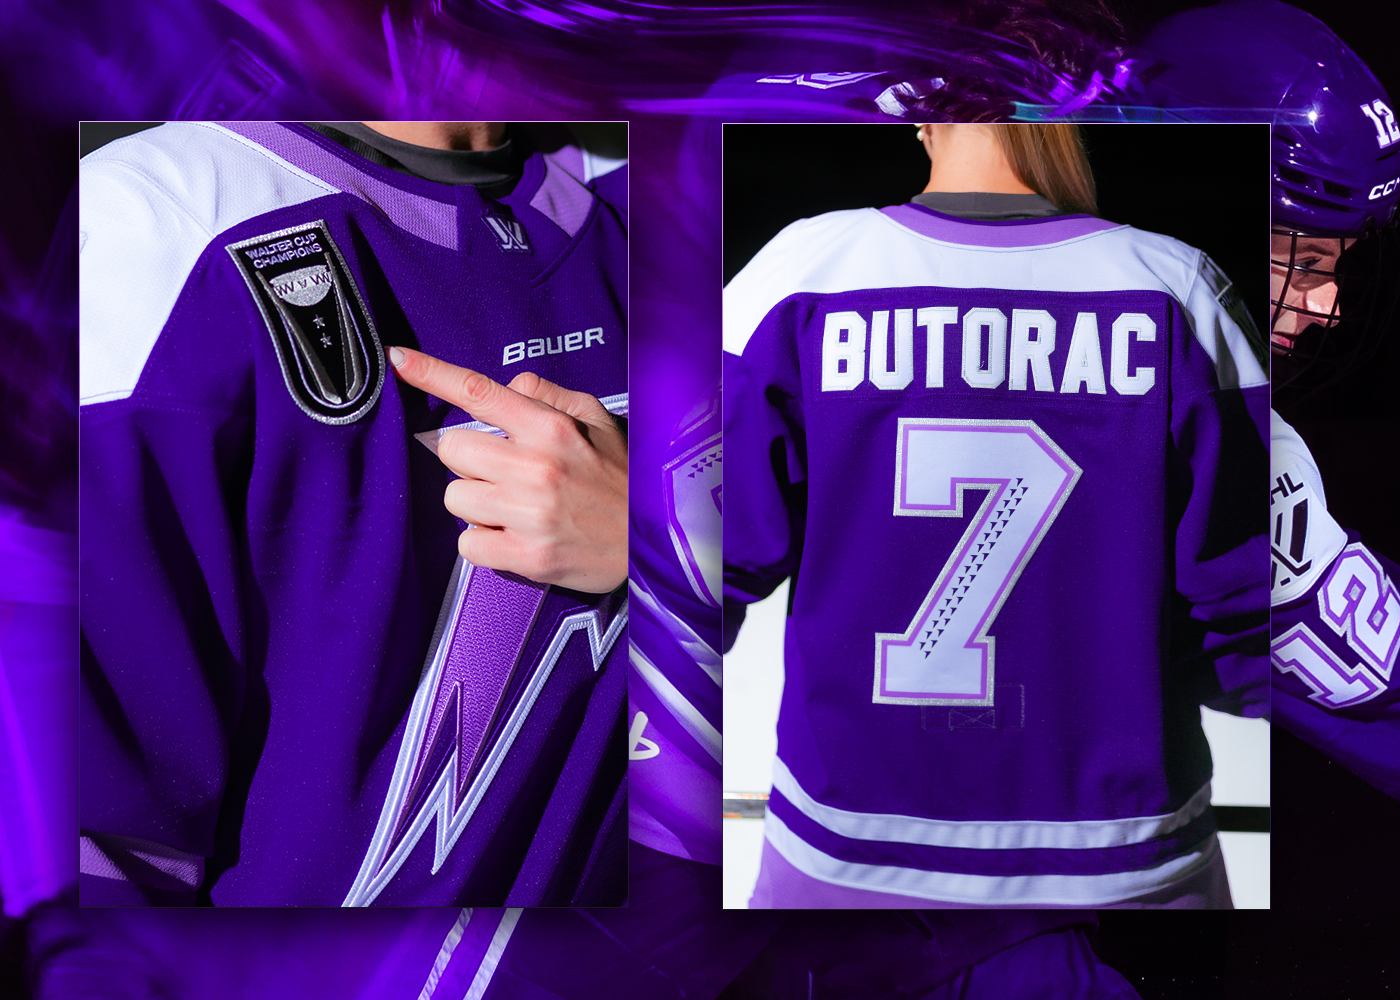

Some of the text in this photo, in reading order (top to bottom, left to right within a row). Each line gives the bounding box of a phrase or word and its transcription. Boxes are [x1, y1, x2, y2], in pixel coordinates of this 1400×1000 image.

[245, 233, 317, 260] WALTER CUP
[253, 243, 323, 269] CHAMPIONS
[822, 306, 1157, 395] BUTORAC
[872, 417, 1084, 707] 7
